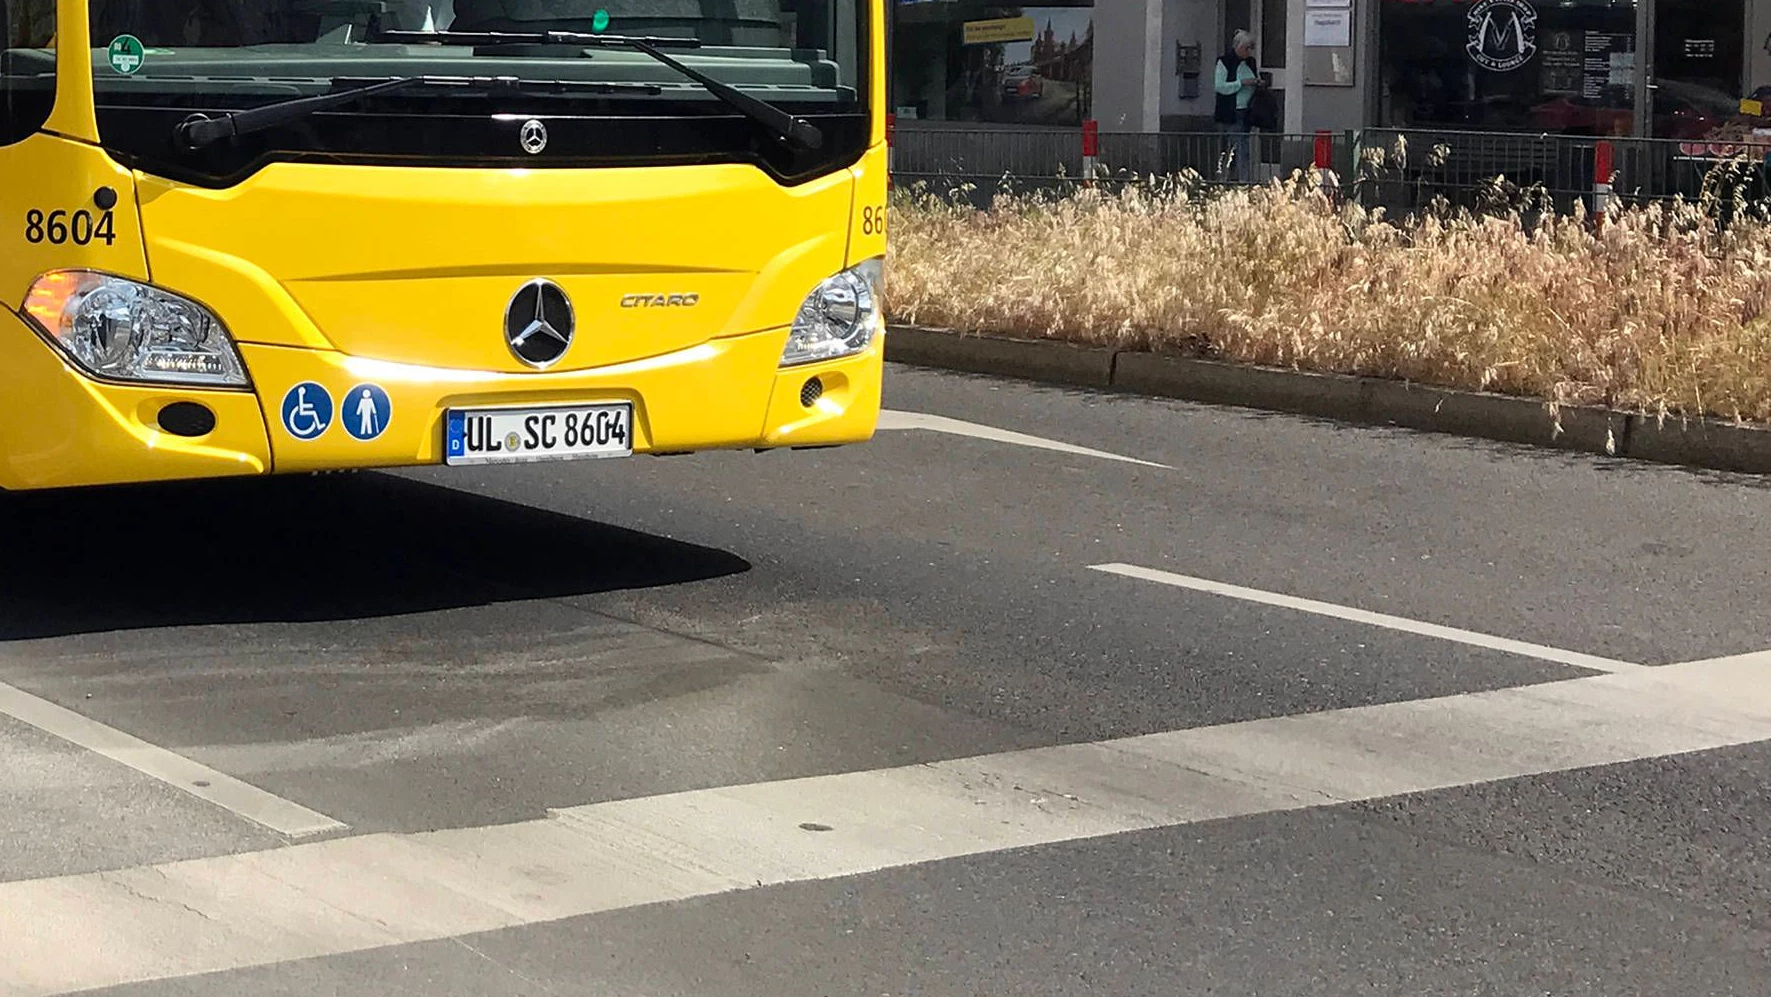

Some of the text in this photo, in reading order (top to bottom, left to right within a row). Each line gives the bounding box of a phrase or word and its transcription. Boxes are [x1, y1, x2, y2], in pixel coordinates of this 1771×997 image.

[25, 209, 116, 245] 8604
[620, 293, 699, 308] CITARO
[467, 410, 626, 452] UL SC 8604
[451, 439, 460, 451] D
